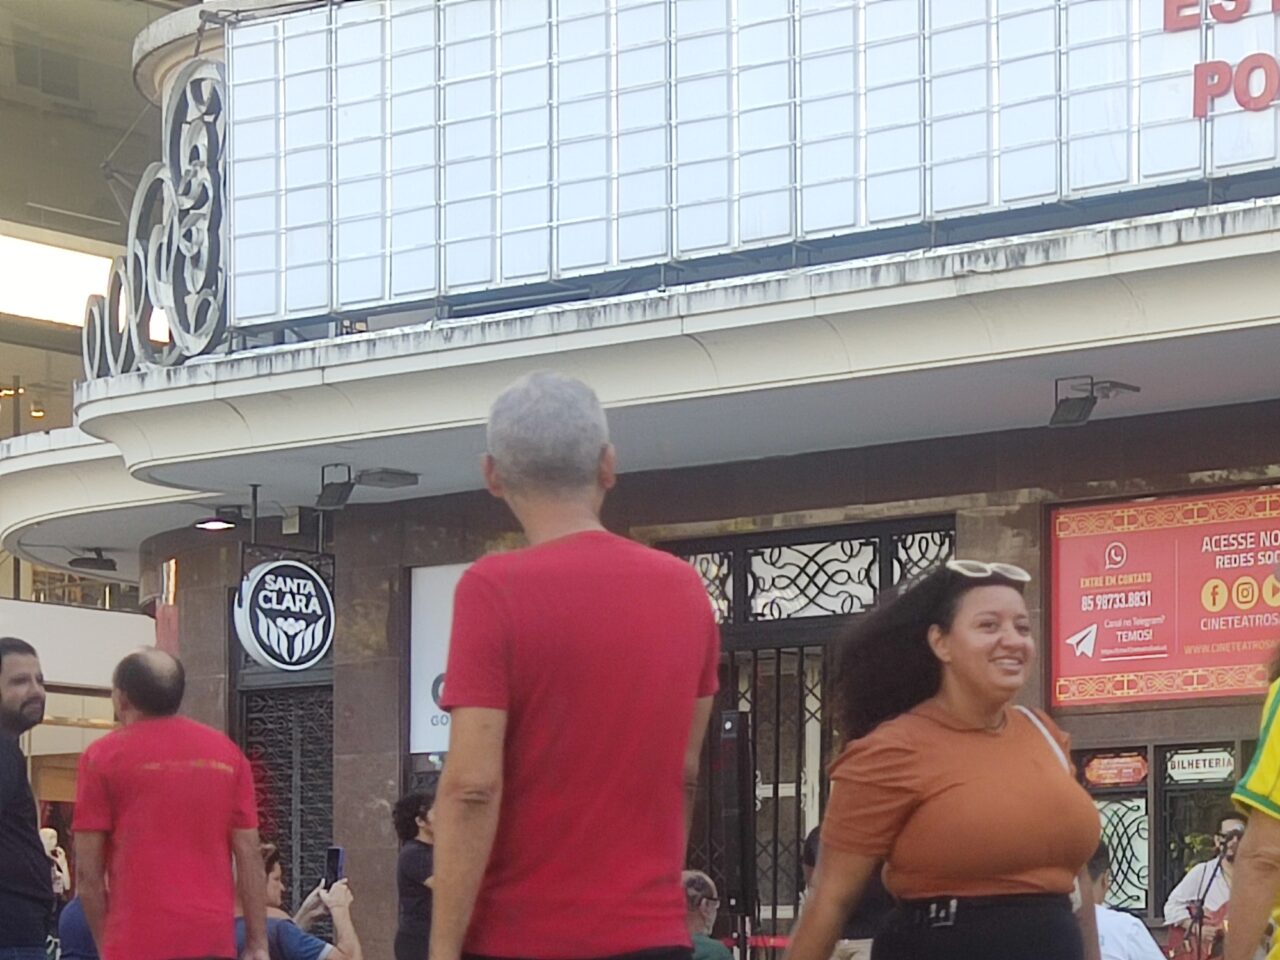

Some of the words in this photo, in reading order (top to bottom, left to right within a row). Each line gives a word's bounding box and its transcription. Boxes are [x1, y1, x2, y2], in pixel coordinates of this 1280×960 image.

[1202, 532, 1256, 553] ACESSE
[1215, 552, 1254, 569] REDES
[265, 574, 316, 596] SANTA
[1080, 576, 1103, 588] ENTRE
[1105, 576, 1117, 586] EM
[1118, 572, 1152, 585] CONTATO
[258, 590, 322, 615] CLARA
[1081, 595, 1094, 611] 85
[1116, 629, 1153, 642] TEMOS!
[1170, 758, 1233, 770] BILHETERIA
